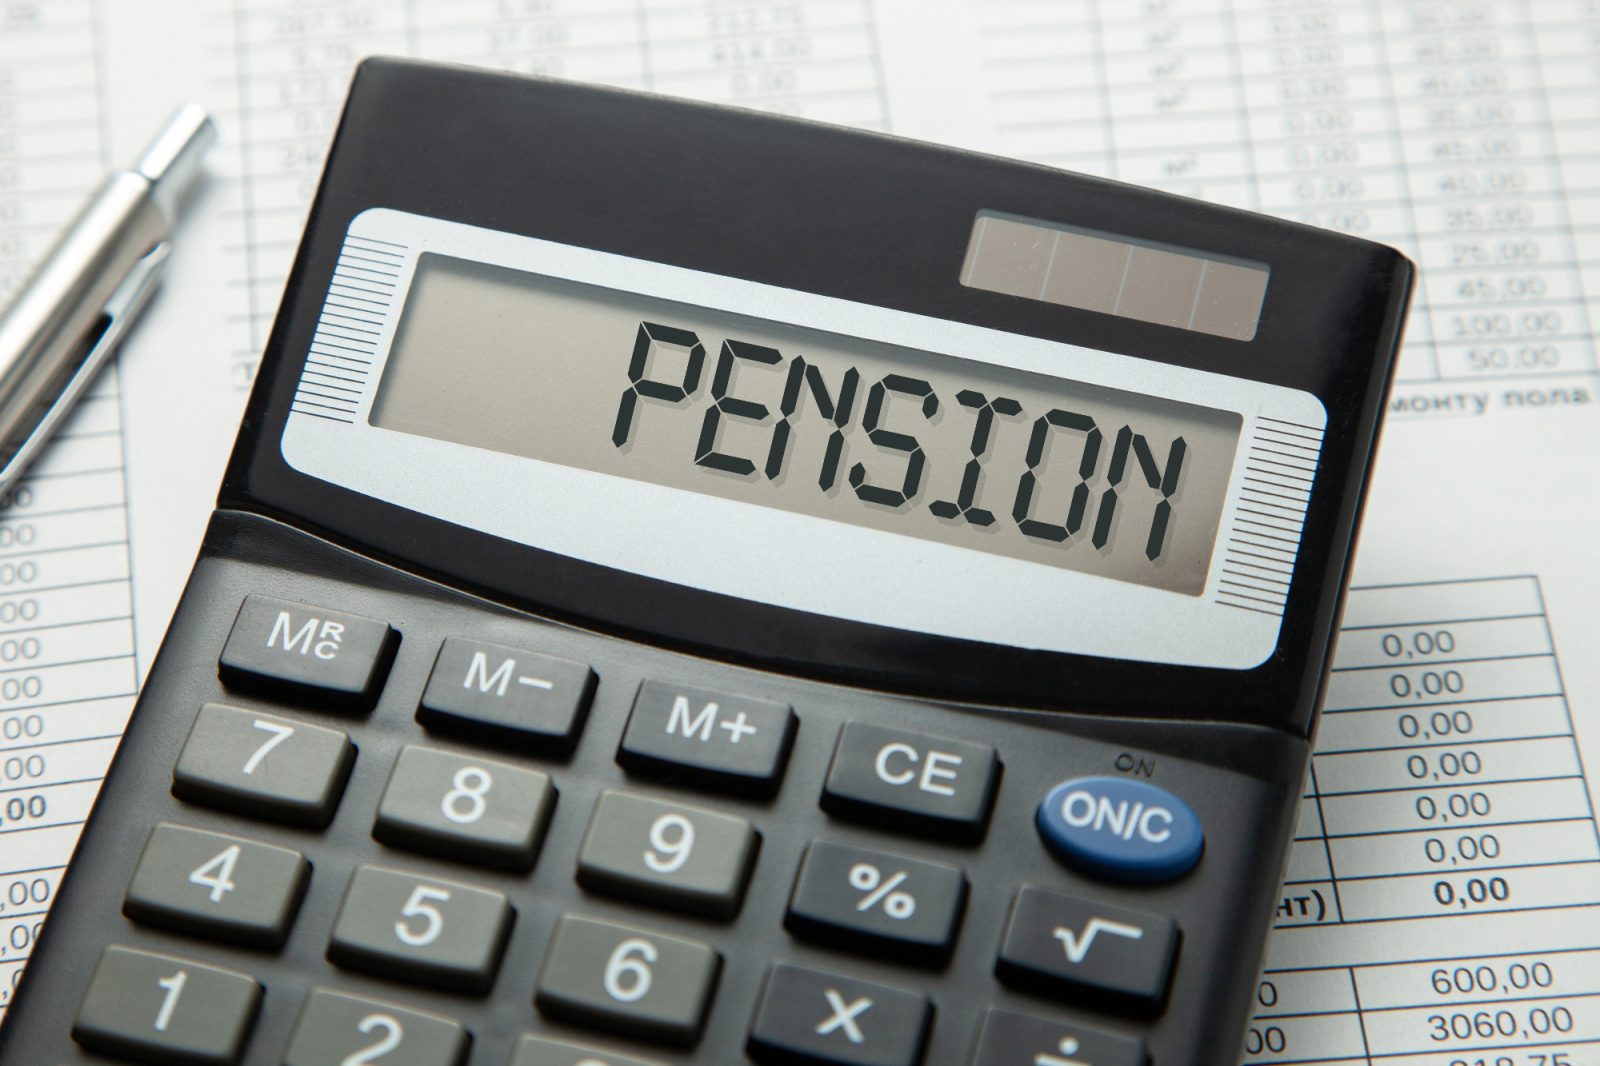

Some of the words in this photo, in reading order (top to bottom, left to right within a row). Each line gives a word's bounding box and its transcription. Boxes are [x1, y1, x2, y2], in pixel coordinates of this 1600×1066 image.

[612, 321, 1187, 562] PENSION
[1382, 630, 1455, 659] 0,00
[1390, 670, 1464, 699] 0,00
[665, 695, 756, 742] M+
[1398, 710, 1473, 739] 0,00
[243, 719, 294, 775] 7
[875, 743, 963, 796] CE
[1114, 753, 1156, 777] ON
[1407, 751, 1482, 781] 0,00
[441, 767, 492, 824] 8
[1061, 791, 1173, 843] ON/C
[1415, 792, 1490, 822] 0,00
[644, 813, 695, 873] 9
[1424, 834, 1501, 865] 0,00
[188, 845, 241, 903] 4
[848, 863, 916, 919] %
[1434, 876, 1510, 909] 0,00
[394, 884, 451, 946] 5
[604, 938, 659, 1001] 6
[1431, 962, 1553, 994] 600,00
[155, 971, 188, 1031] 1
[1427, 1006, 1574, 1039] 3060,00
[341, 1014, 404, 1066] 2
